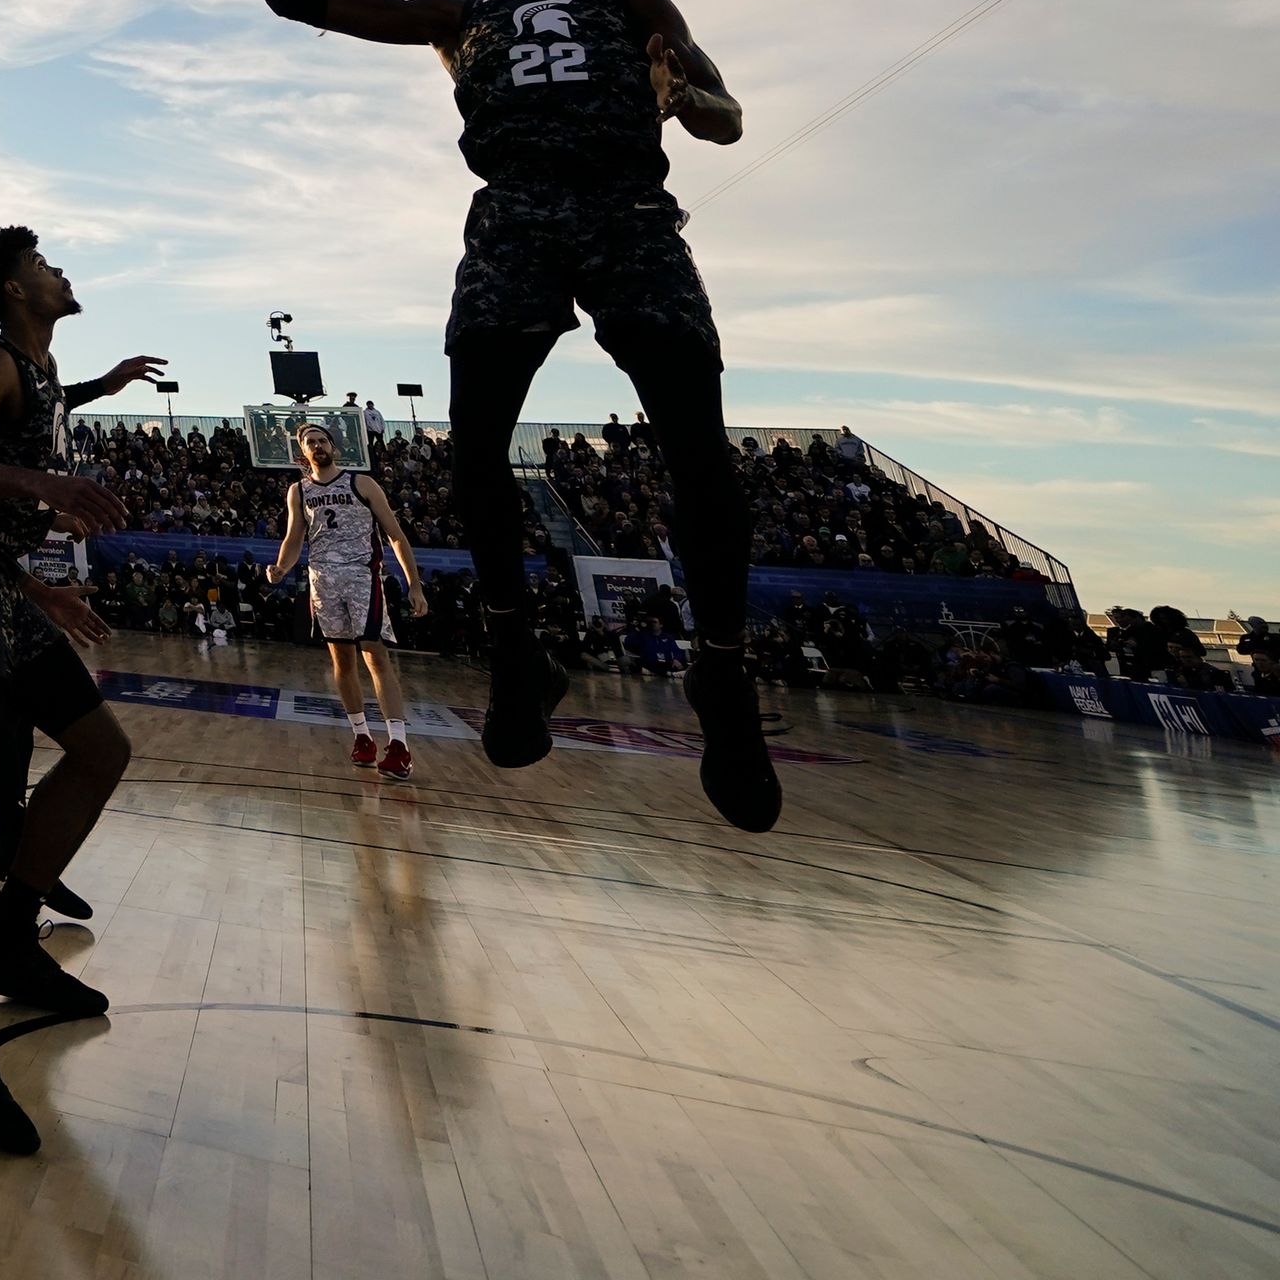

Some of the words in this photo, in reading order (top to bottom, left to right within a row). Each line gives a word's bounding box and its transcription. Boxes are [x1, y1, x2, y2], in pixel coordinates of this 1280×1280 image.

[508, 42, 589, 88] 22
[306, 493, 354, 508] GONZAGA
[324, 508, 338, 529] 2
[1068, 684, 1090, 700] NAVY
[1074, 697, 1110, 714] FEDERAL
